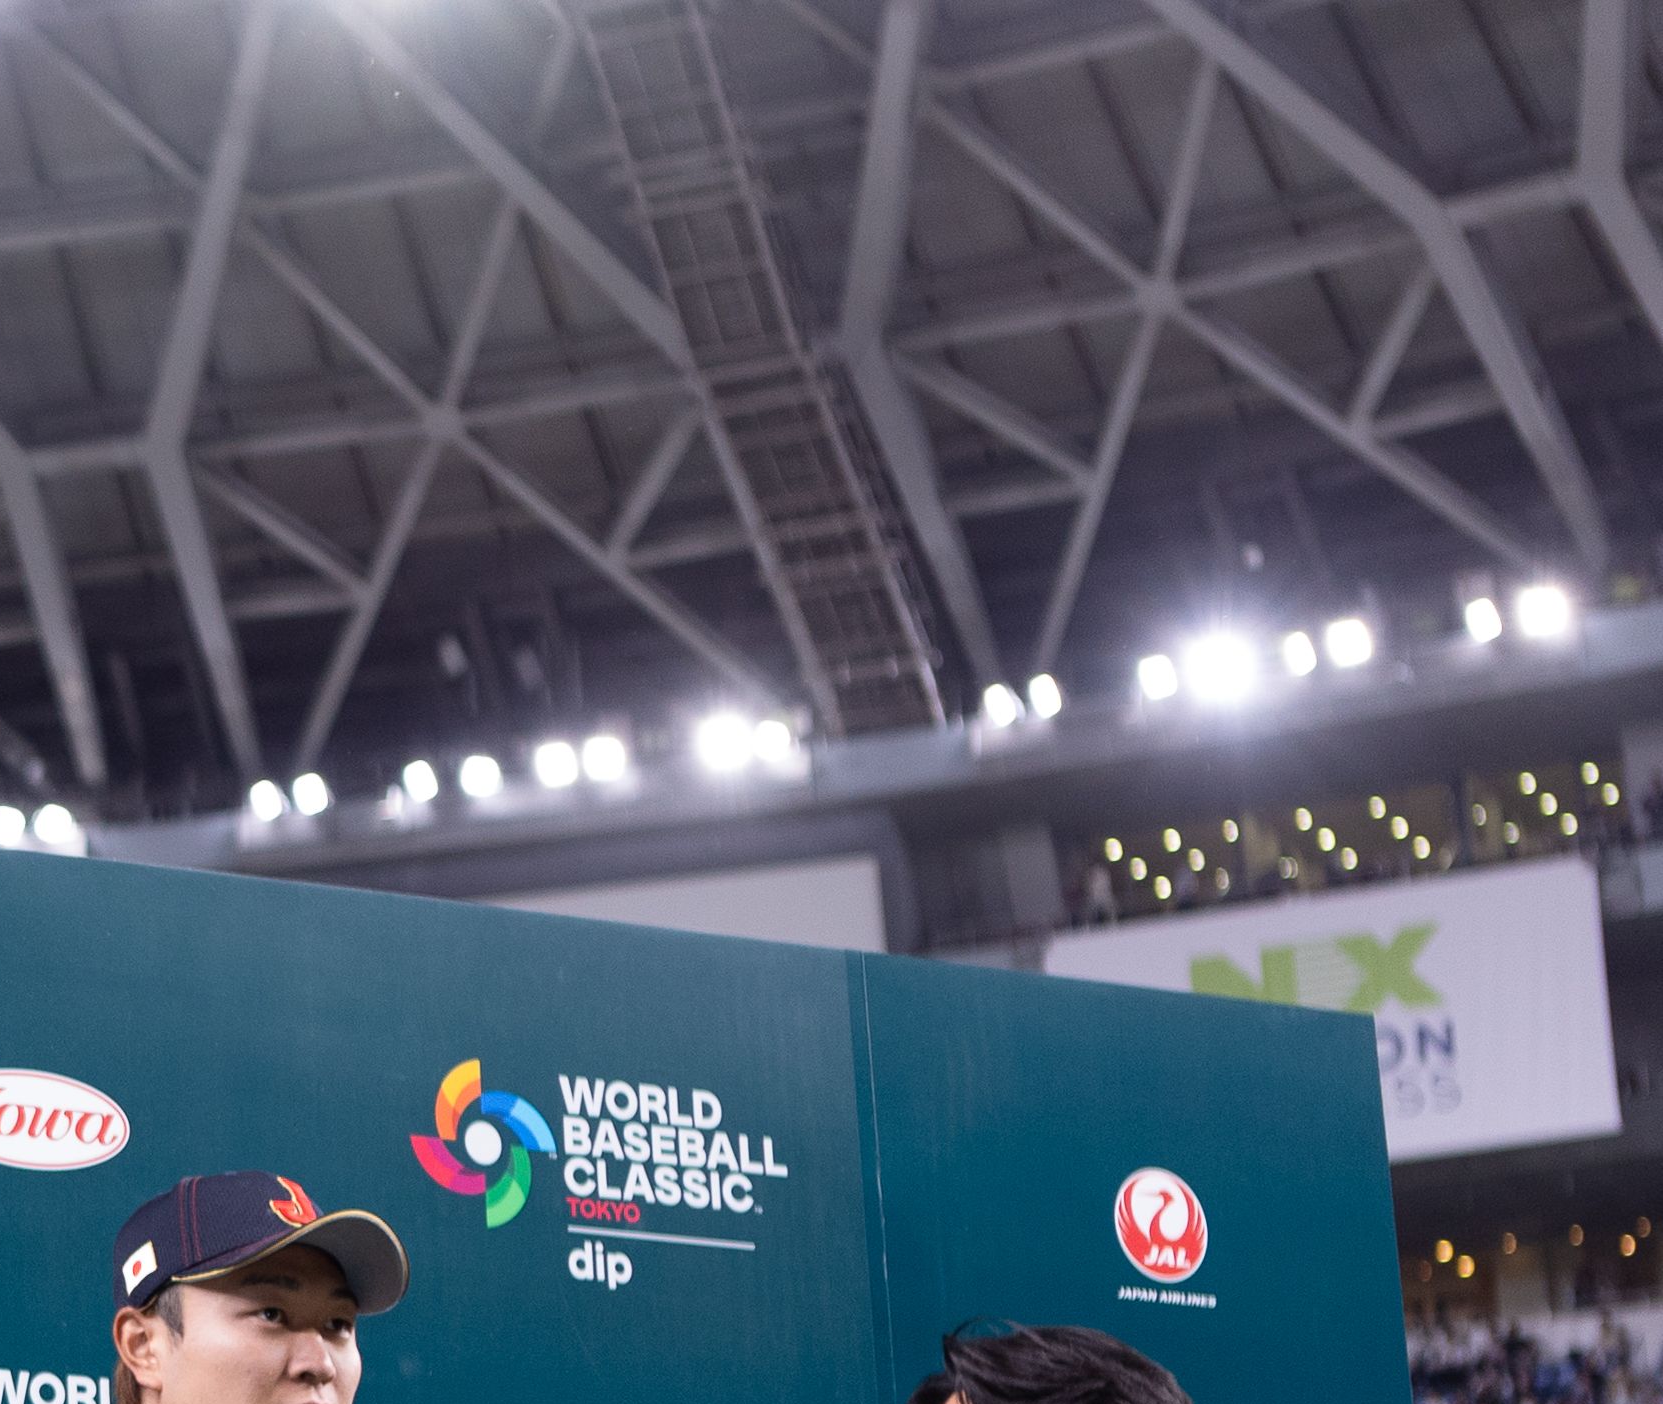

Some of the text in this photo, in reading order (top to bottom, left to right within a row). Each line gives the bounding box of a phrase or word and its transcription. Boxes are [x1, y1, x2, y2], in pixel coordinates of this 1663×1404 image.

[558, 1074, 723, 1130] WORLD
[562, 1115, 788, 1178] BASEBALL
[563, 1157, 754, 1214] CLASSIC
[566, 1196, 641, 1224] TOKYO
[567, 1240, 633, 1290] dip
[1144, 1244, 1191, 1269] JAL
[1118, 1285, 1217, 1309] JAPAN AIRLINES
